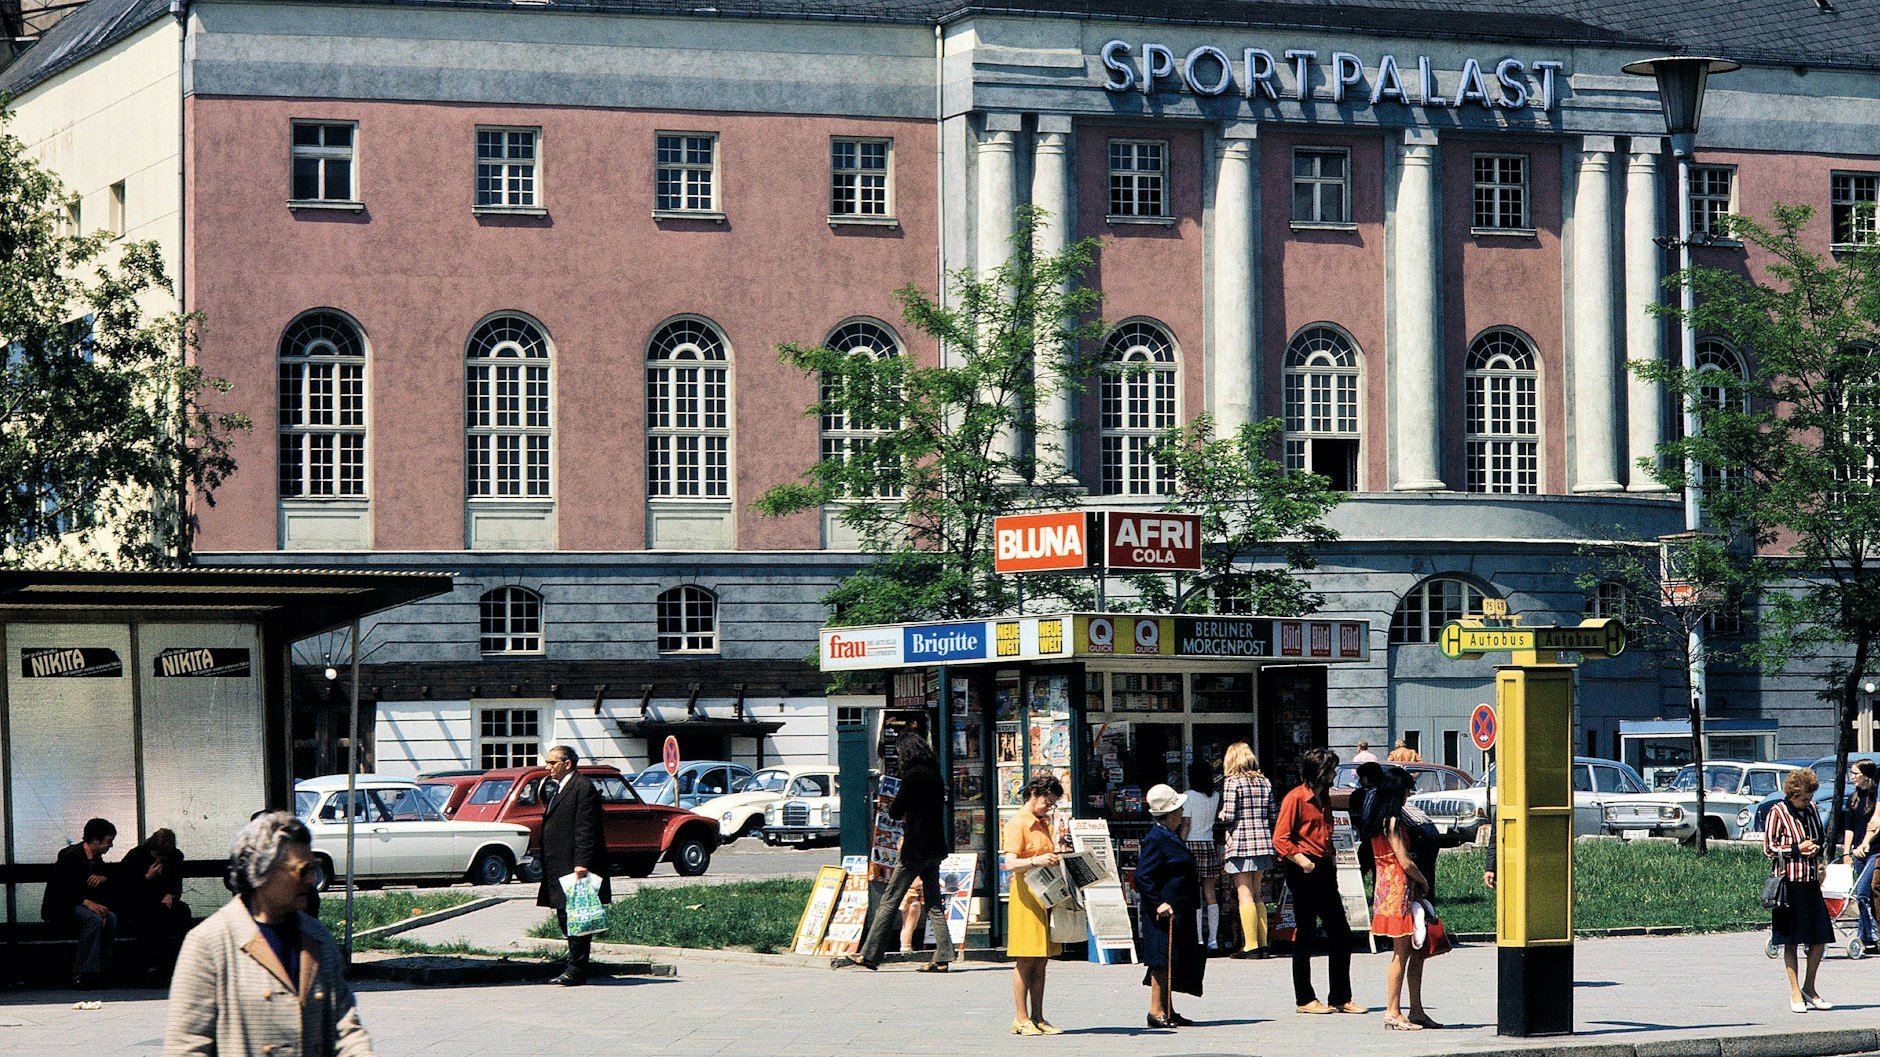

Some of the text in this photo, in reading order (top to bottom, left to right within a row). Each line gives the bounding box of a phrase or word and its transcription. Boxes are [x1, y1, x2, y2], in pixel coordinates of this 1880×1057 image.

[1101, 40, 1563, 112] SPORTPALAST
[998, 525, 1083, 560] BLUNA
[1115, 518, 1193, 549] AFRI
[1132, 549, 1176, 563] COLA
[997, 623, 1019, 639] NEUE
[1039, 620, 1062, 637] NEUE
[1195, 621, 1254, 638] BERLINER
[1283, 625, 1301, 649] Bild
[1312, 625, 1330, 650] Bild
[1341, 626, 1359, 650] Bild
[1447, 628, 1461, 653] H
[1470, 633, 1525, 646] Autobus
[1545, 632, 1599, 647] Autobus
[830, 635, 866, 659] frau
[912, 631, 977, 656] Brigitte
[998, 639, 1019, 655] WELT
[1040, 637, 1062, 653] WELT
[1183, 638, 1266, 655] MORGENPOST
[31, 648, 85, 677] NIKITA
[161, 648, 214, 677] NIKITA
[894, 673, 925, 697] BUNTE
